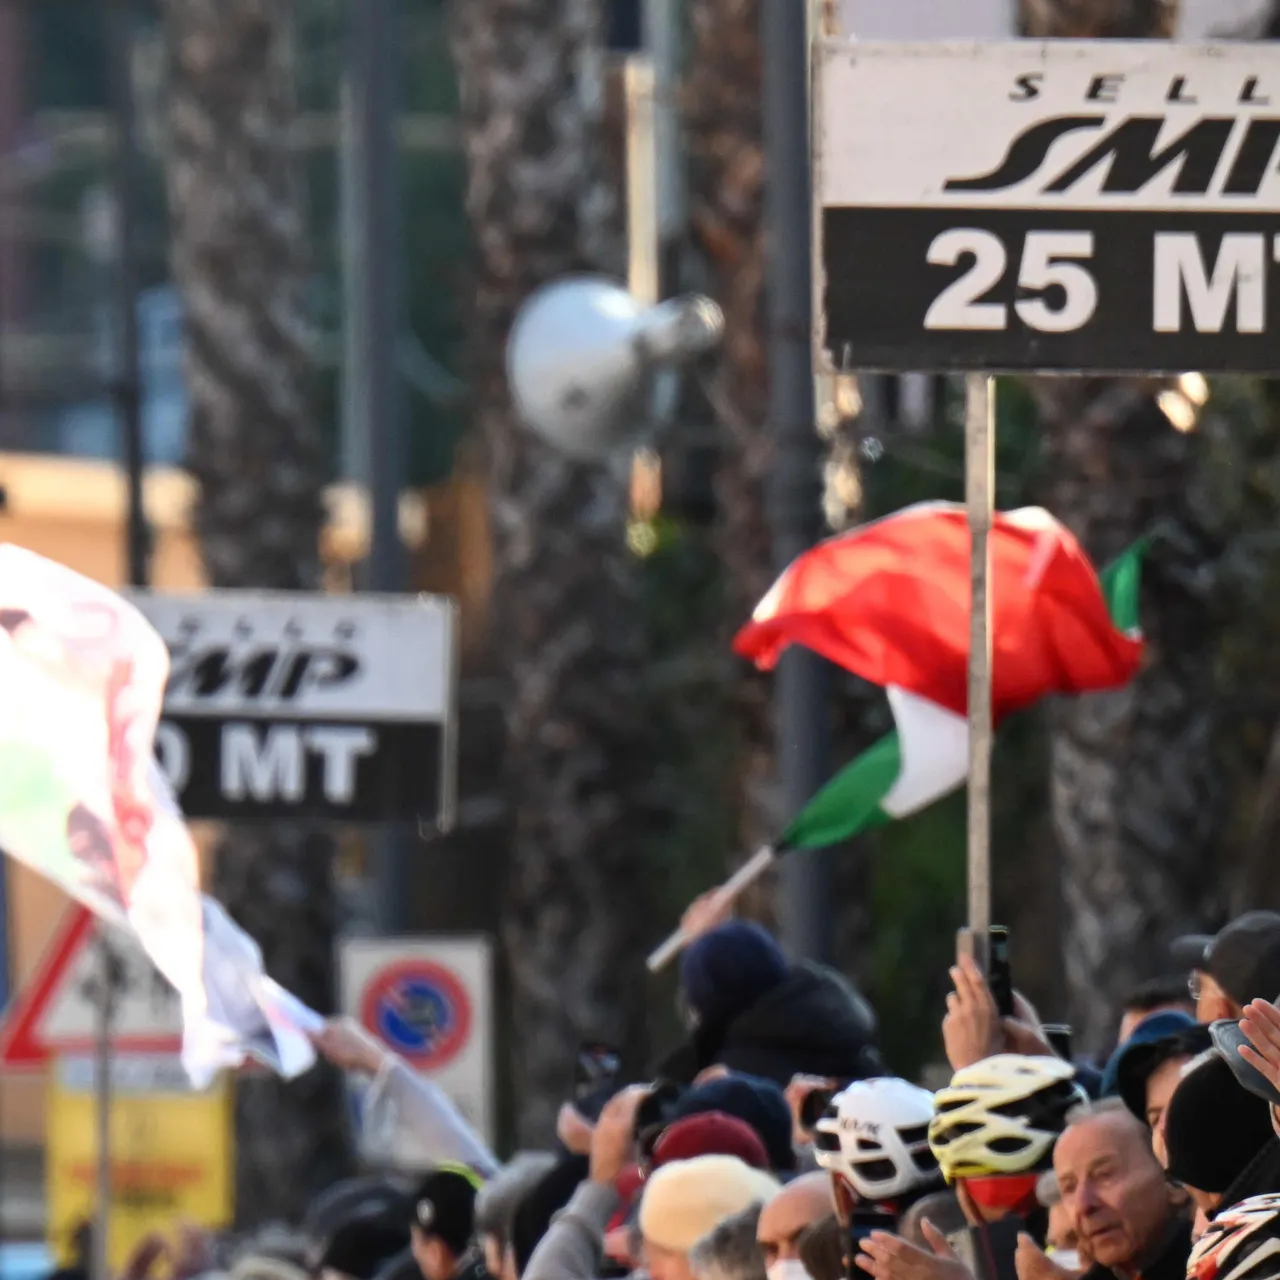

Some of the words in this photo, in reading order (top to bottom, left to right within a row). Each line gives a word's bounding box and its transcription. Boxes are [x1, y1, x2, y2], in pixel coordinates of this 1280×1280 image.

[1008, 74, 1272, 104] SELL
[923, 227, 1098, 332] 25
[1153, 231, 1280, 333] M
[162, 646, 362, 702] MP
[151, 722, 191, 796] 0
[220, 724, 378, 804] MT
